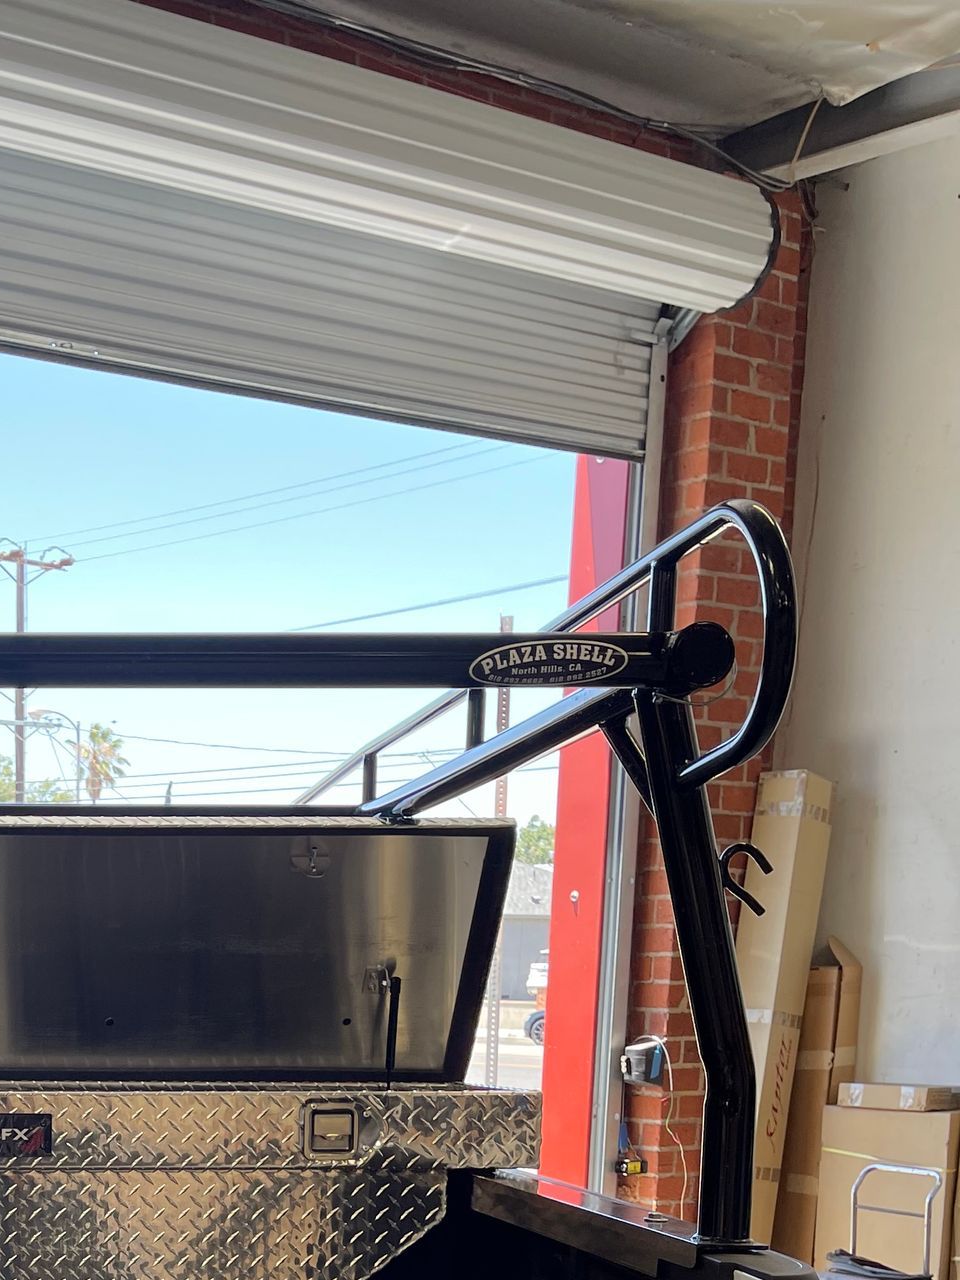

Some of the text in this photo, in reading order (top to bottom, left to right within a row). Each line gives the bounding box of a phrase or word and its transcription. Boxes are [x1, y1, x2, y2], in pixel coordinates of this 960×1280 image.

[480, 644, 616, 675] PLAZA SHELL
[511, 664, 538, 675] North
